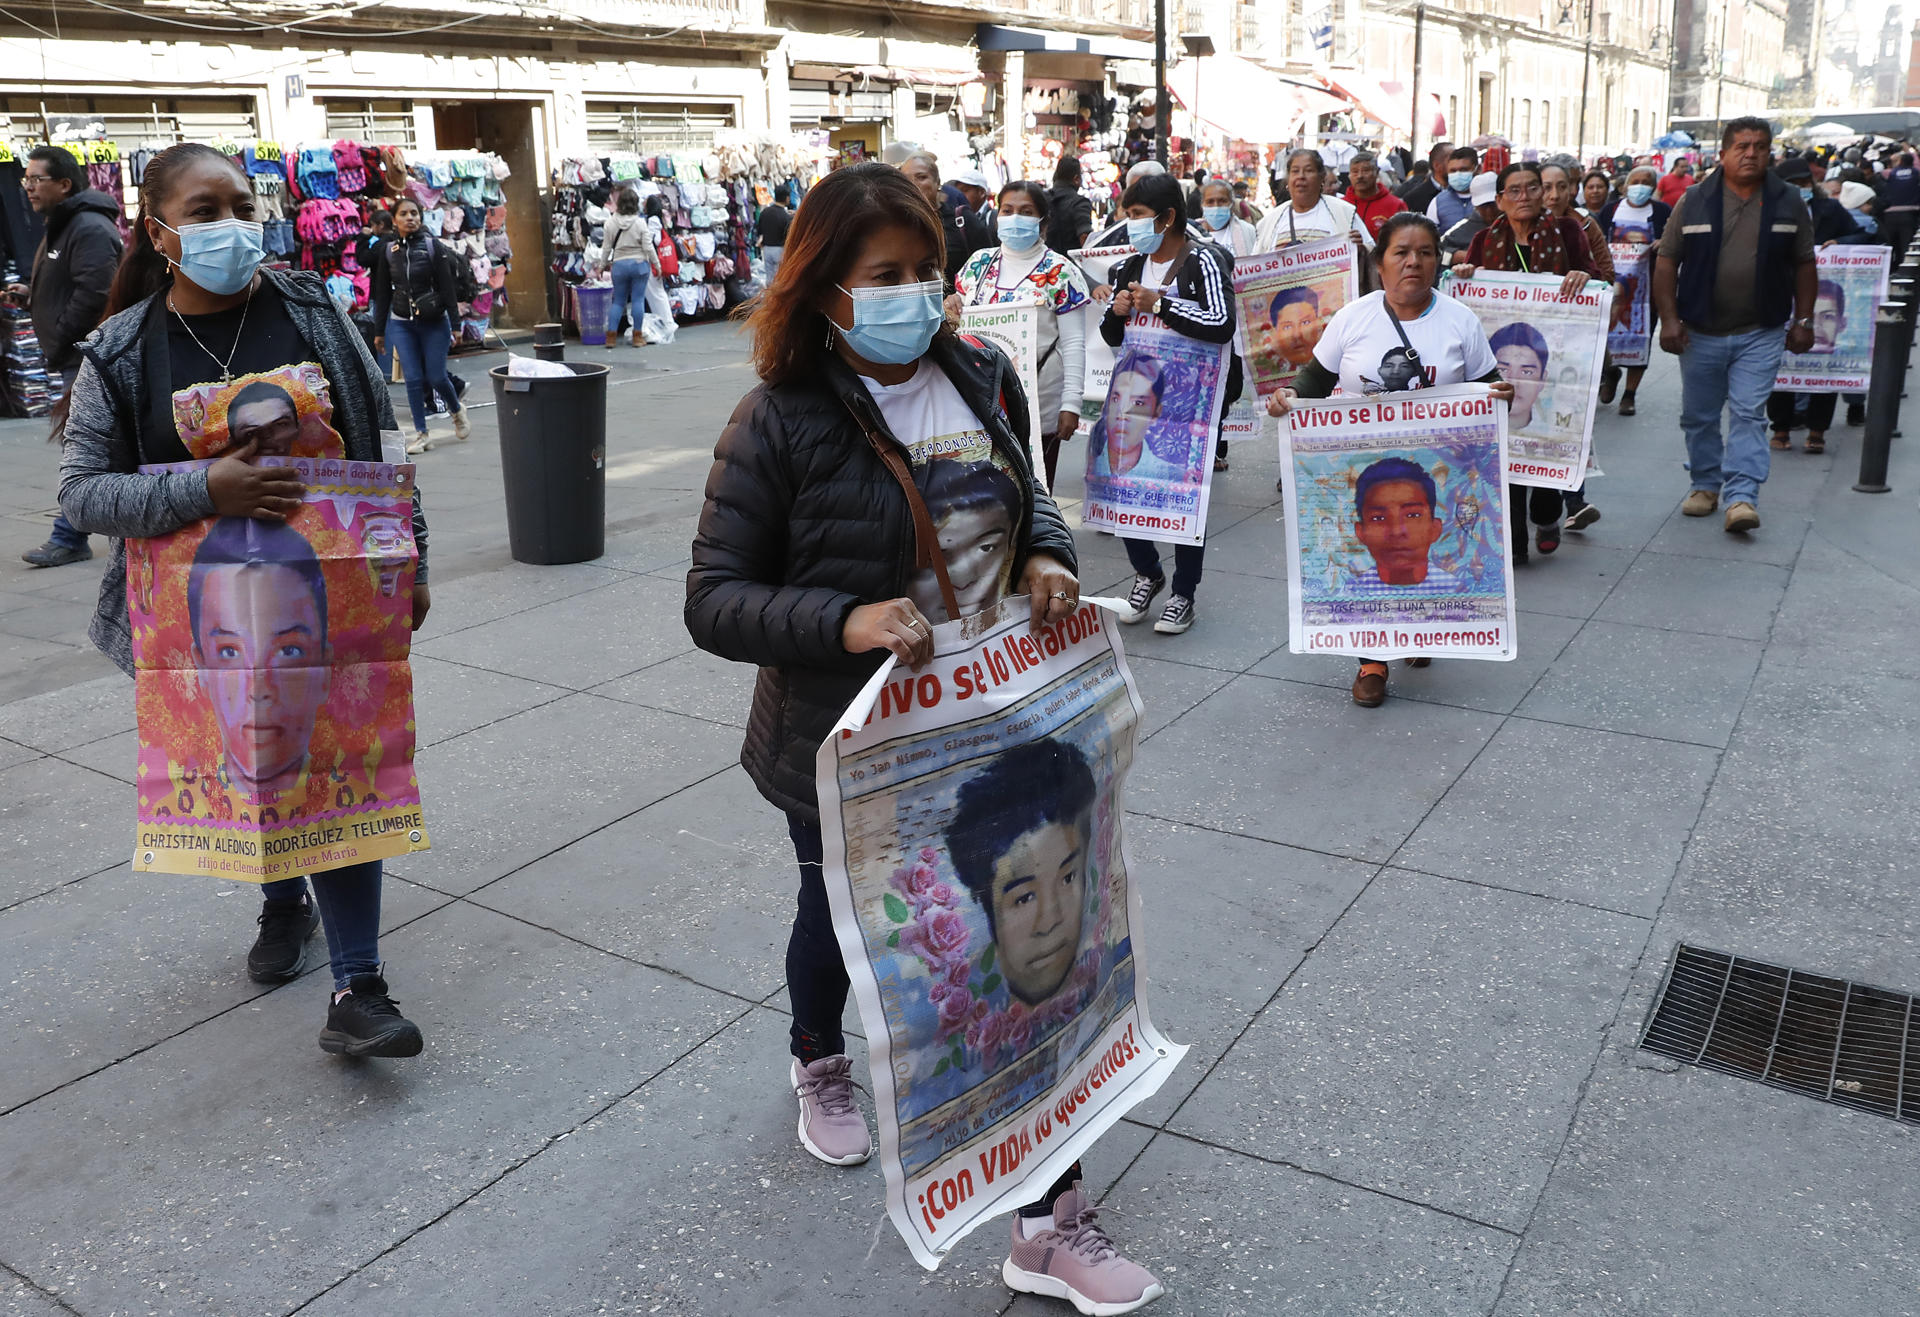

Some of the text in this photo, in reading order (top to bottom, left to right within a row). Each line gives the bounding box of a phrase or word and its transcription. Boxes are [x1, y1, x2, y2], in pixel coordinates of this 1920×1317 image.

[94, 148, 112, 162] 60
[1232, 264, 1262, 280] ¡Vivo
[1265, 260, 1279, 271] se
[1282, 256, 1294, 267] lo
[1296, 243, 1348, 264] llevaron!
[1830, 254, 1882, 266] llevaron!
[1452, 282, 1600, 307] ¡Vivo se lo llevaron!
[968, 310, 1019, 328] llevaron!
[1134, 311, 1149, 327] lo
[1791, 375, 1802, 385] lo
[1804, 378, 1864, 388] queremos!
[1289, 395, 1494, 431] ¡Vivo se lo llevaron!
[1221, 422, 1253, 432] emos!
[935, 435, 975, 453] DONDE
[314, 466, 346, 478] saber
[350, 467, 382, 480] donde
[1144, 490, 1195, 506] GUERRERO
[1397, 602, 1426, 613] LUNA
[1433, 600, 1476, 612] TORRES
[1309, 627, 1501, 650] ¡Con VIDA lo queremos!
[952, 659, 988, 701] se
[982, 646, 1010, 687] lo
[1003, 602, 1101, 675] llevaron!
[850, 768, 865, 783] Yo
[870, 760, 891, 776] Jan
[943, 731, 1000, 751] Glasgow,
[1044, 698, 1066, 718] quiero
[1065, 686, 1081, 703] saber
[142, 812, 421, 857] CHRISTIAN ALFONSO RODRÍGUEZ TELUMBRE
[197, 846, 359, 875] Hijo de Clemente y Luz María
[918, 1022, 1142, 1234] ¡Con VIDA lo queremos!
[944, 1125, 969, 1147] Hijo
[972, 1117, 985, 1130] de
